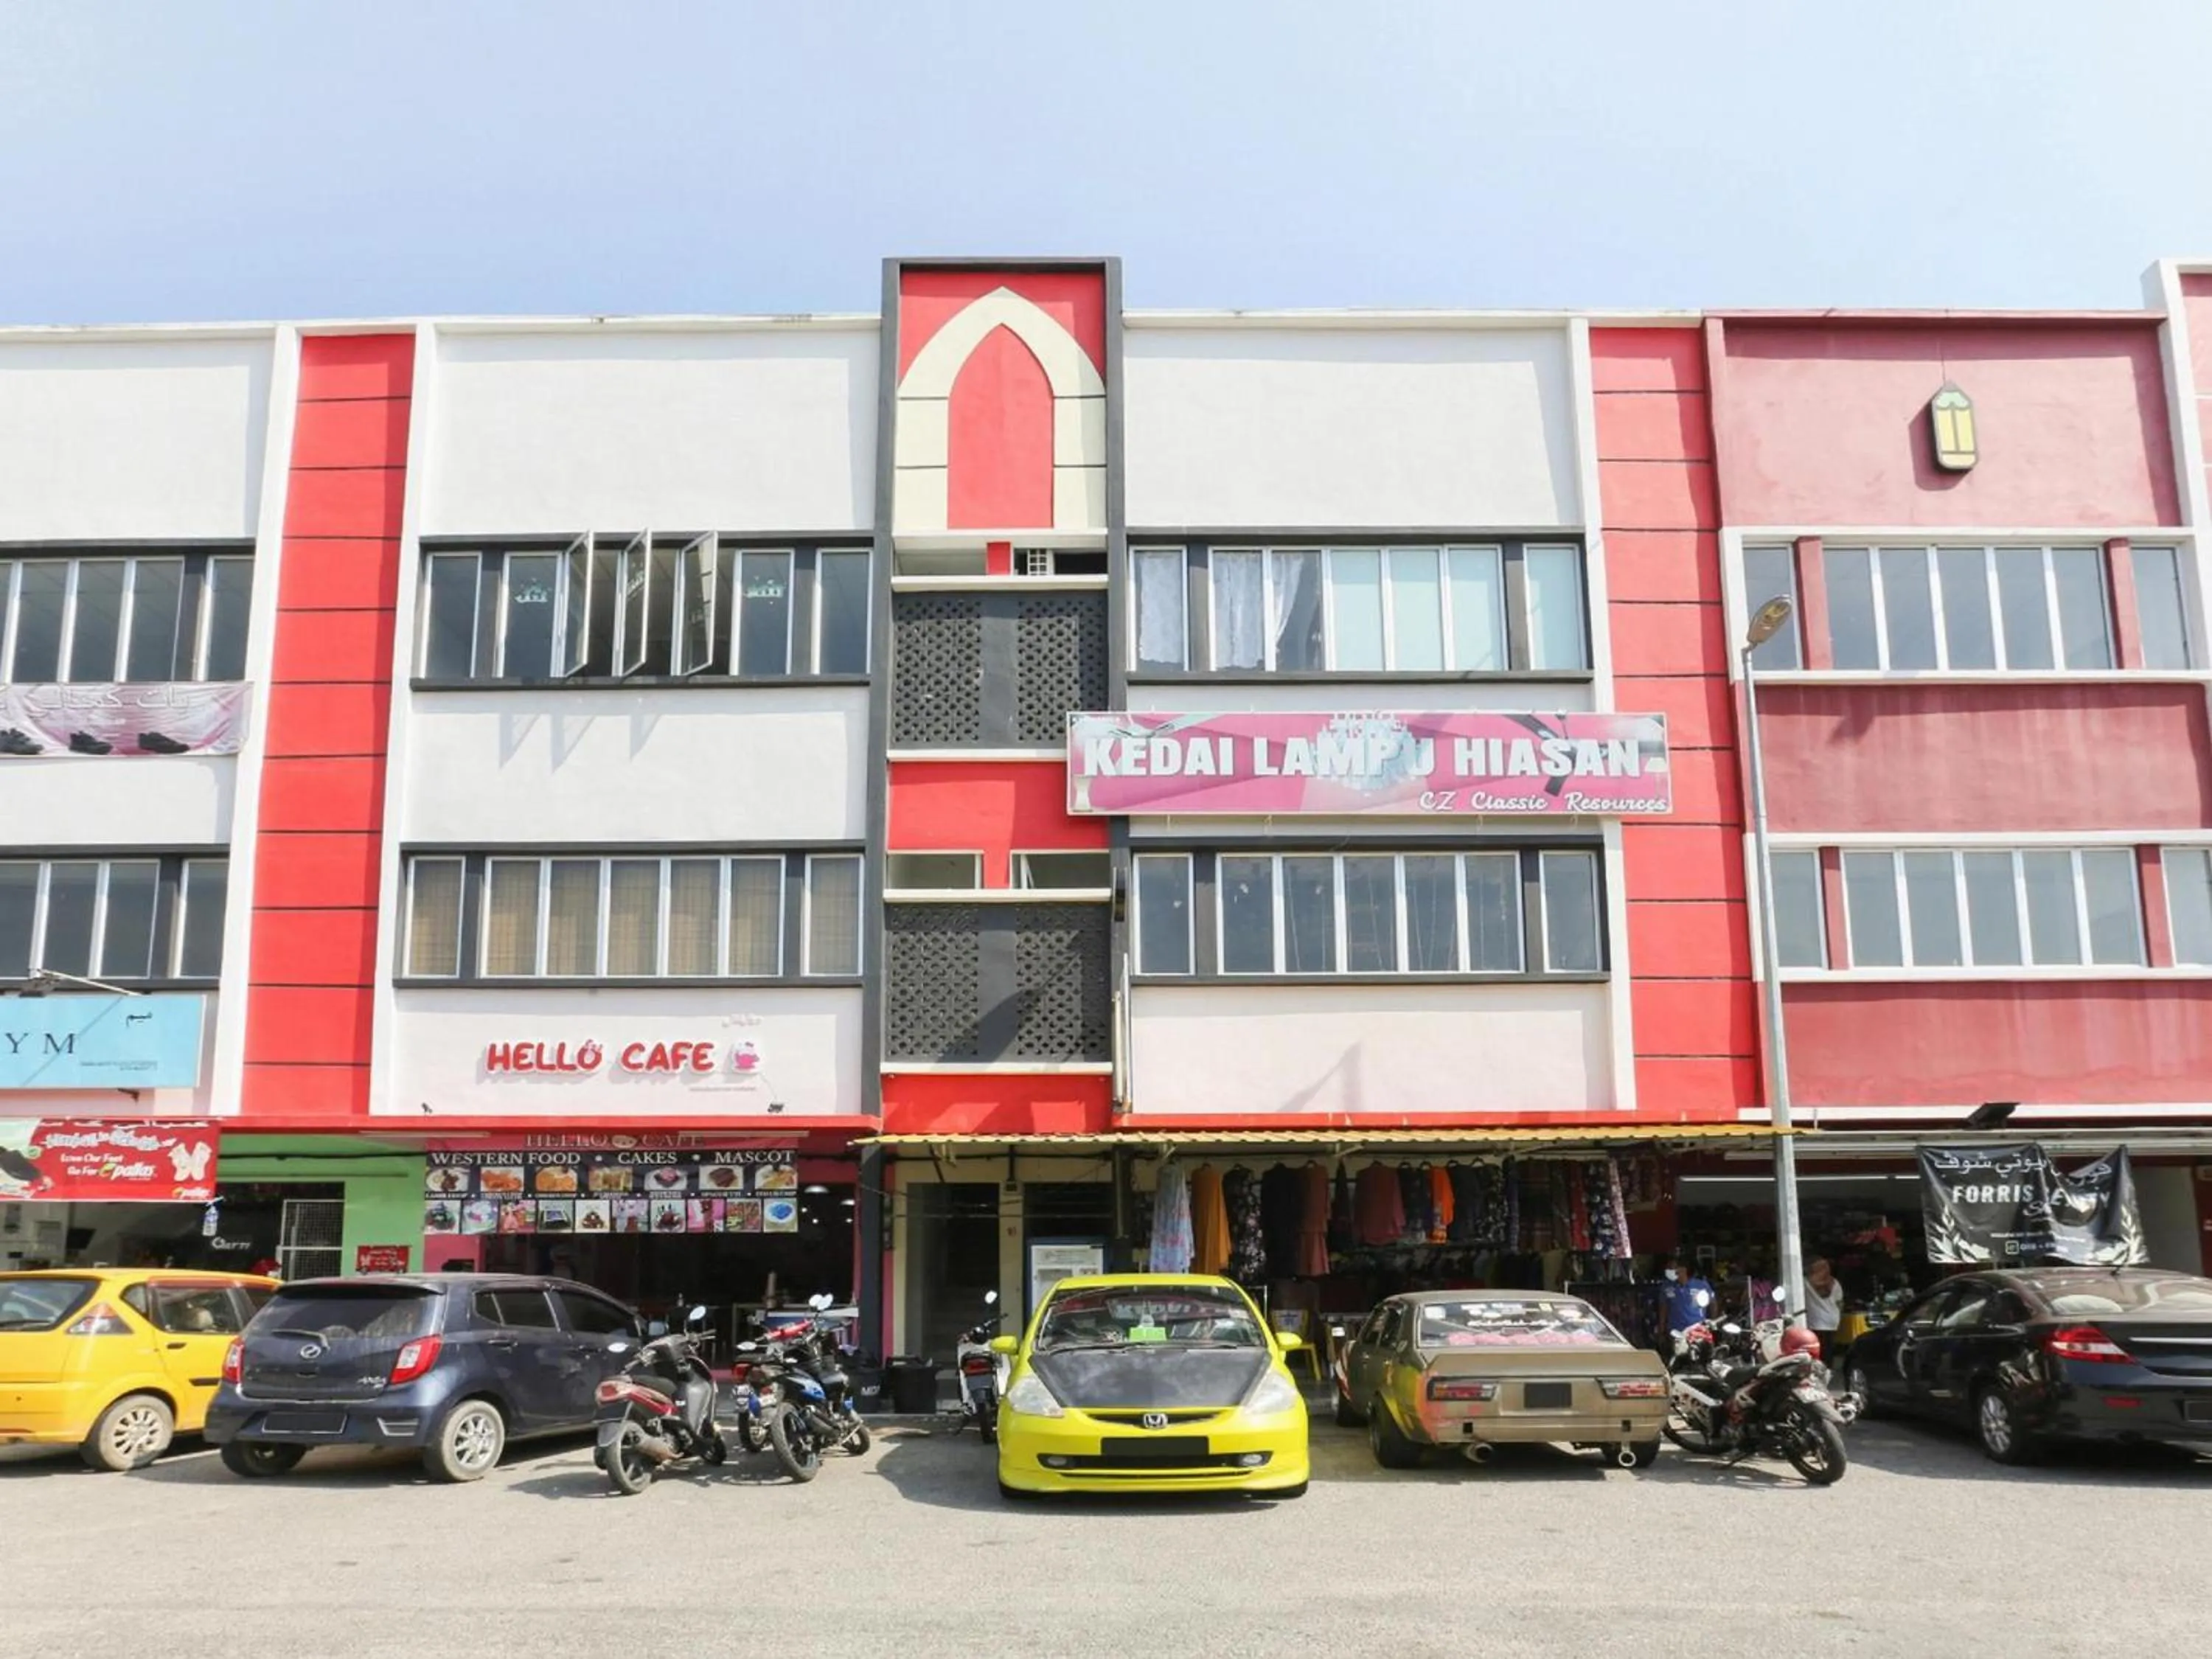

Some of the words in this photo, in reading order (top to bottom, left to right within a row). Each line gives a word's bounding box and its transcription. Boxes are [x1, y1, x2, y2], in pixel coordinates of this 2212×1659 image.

[1084, 737, 1234, 776] KEDAI
[1253, 737, 1435, 776] LAMPU
[1454, 737, 1641, 777] HIASAN
[1419, 790, 1455, 810] CZ
[1471, 790, 1548, 810] Classic
[1563, 790, 1669, 811] Resources
[487, 1040, 603, 1071] HELLO
[620, 1041, 715, 1072] CAFE
[431, 1152, 524, 1165] WESTERN
[528, 1152, 581, 1165] FOOD
[617, 1151, 678, 1164] CAKES
[714, 1150, 796, 1164] MASCOT
[1952, 1184, 2034, 1204] FORRIS
